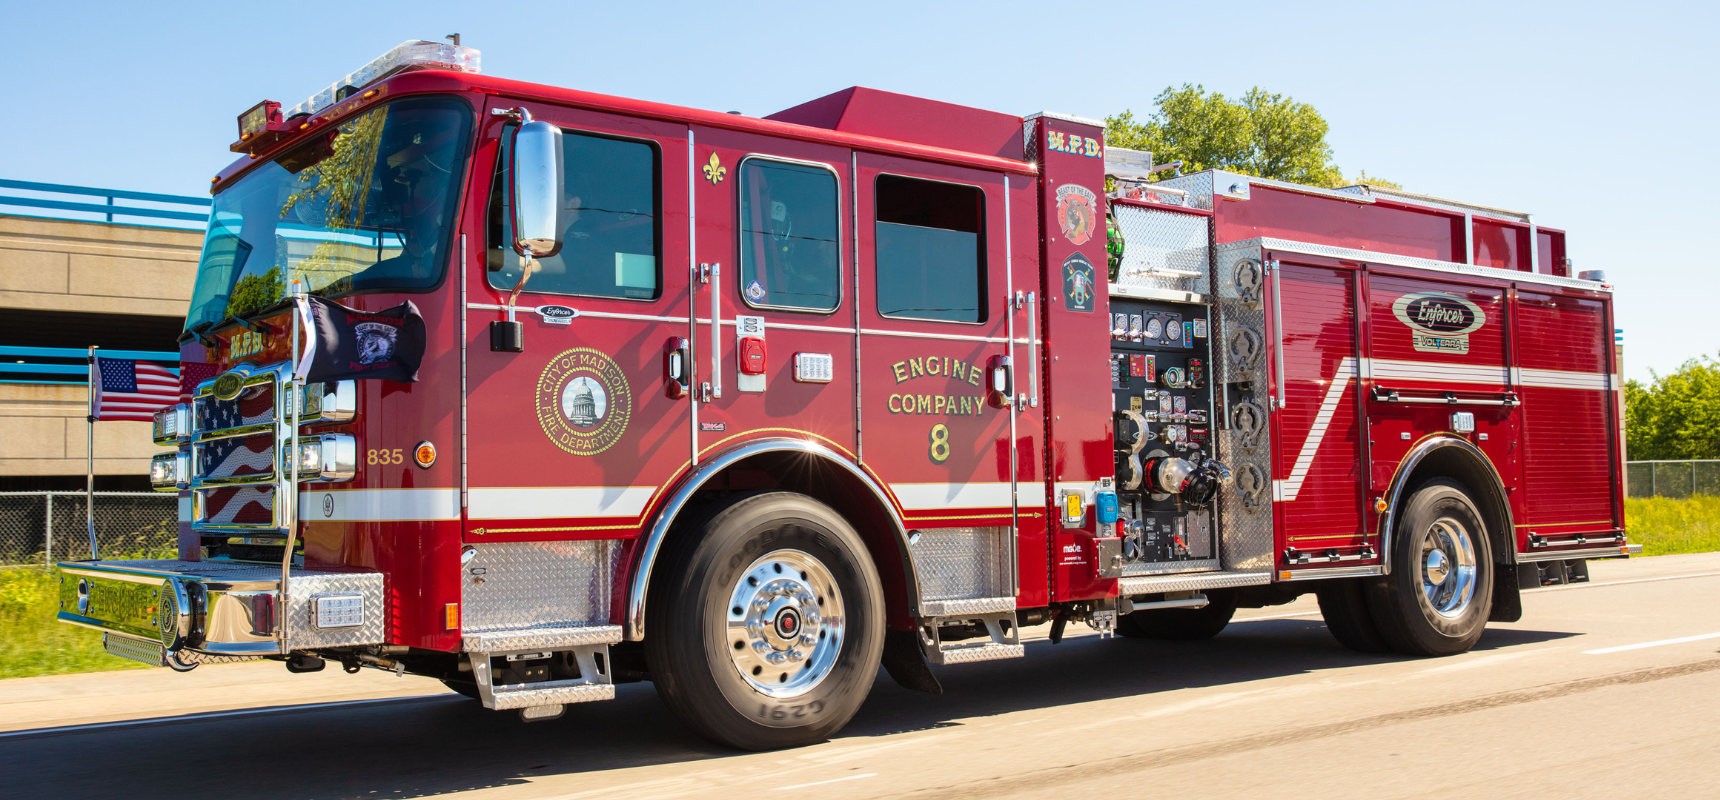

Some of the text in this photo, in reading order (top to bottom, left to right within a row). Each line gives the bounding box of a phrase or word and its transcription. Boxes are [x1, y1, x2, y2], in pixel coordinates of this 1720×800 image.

[1047, 131, 1102, 159] M.F.D.
[1058, 186, 1070, 196] BEAST
[1084, 190, 1095, 201] EAST
[346, 313, 403, 327] MADISON
[547, 307, 571, 317] Enforcer
[1418, 301, 1465, 327] Enforcer
[1421, 336, 1461, 350] VOLTERRA
[543, 354, 625, 395] CITY OF MADISON
[891, 356, 982, 387] ENGINE
[887, 393, 985, 416] COMPANY
[542, 406, 625, 450] FIRE DEPARTMENT
[928, 423, 950, 465] 8
[367, 449, 404, 465] 835
